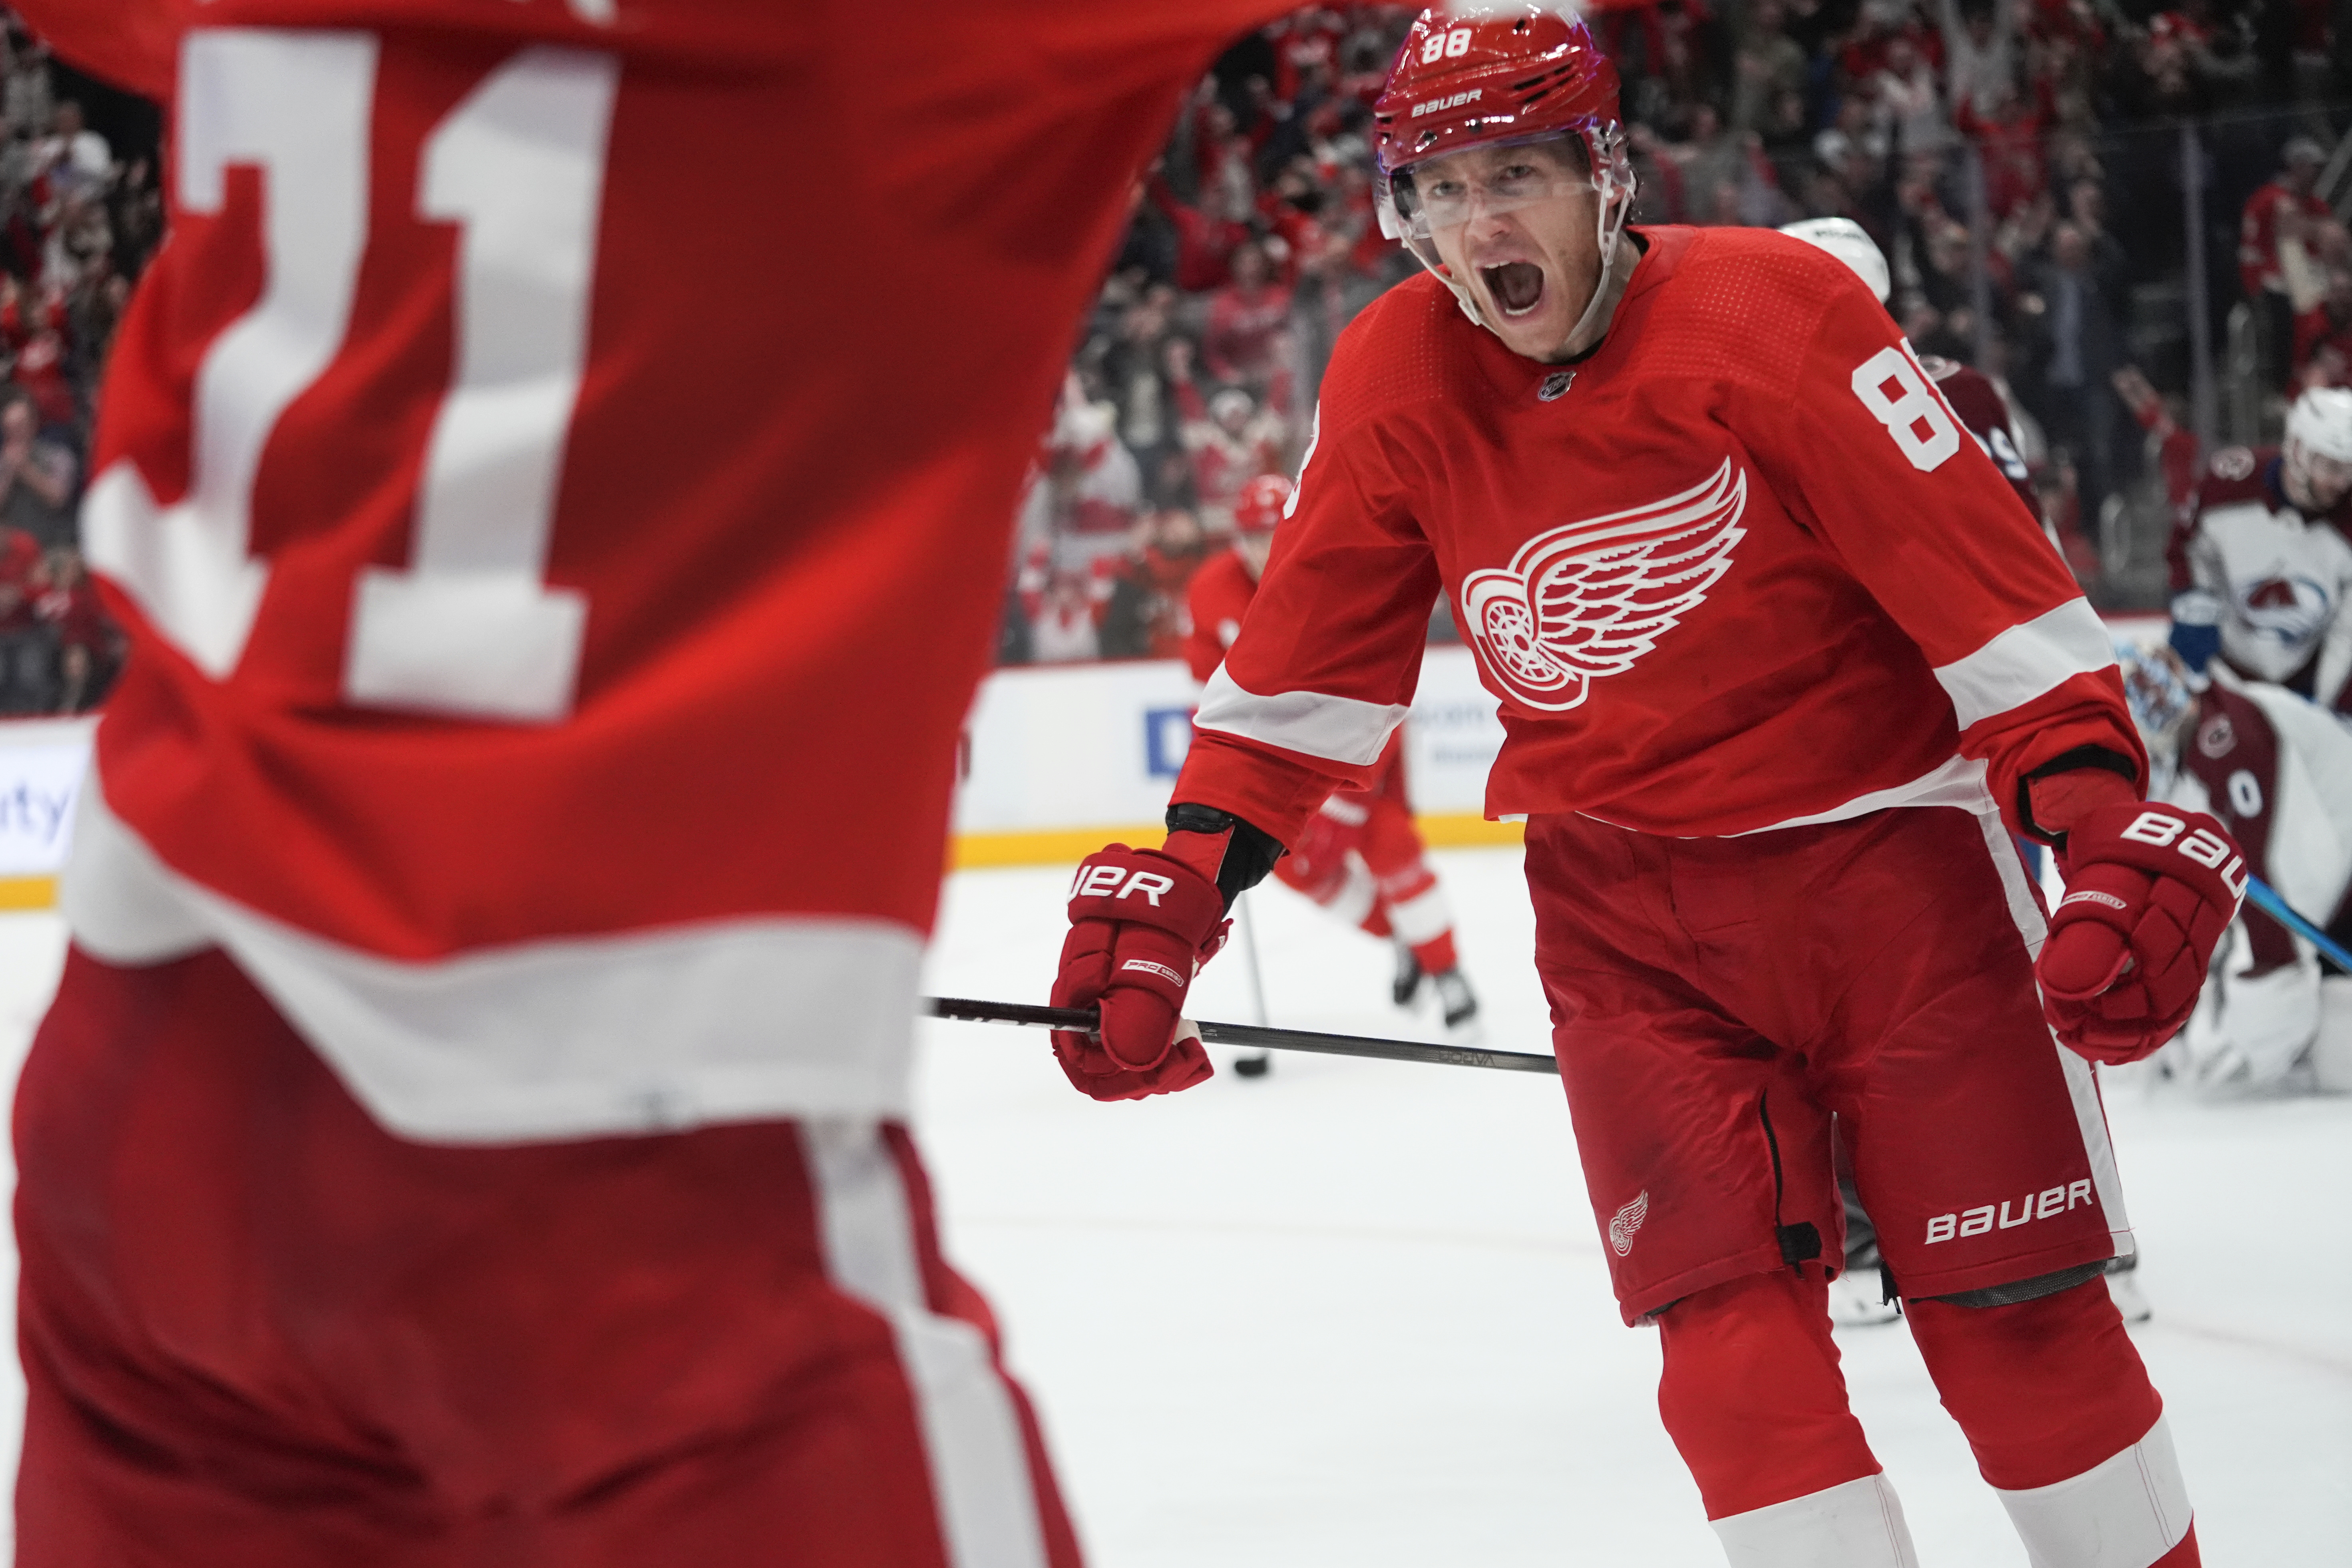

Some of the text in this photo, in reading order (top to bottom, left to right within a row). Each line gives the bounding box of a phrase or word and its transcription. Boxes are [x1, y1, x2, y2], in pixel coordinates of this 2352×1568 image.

[1422, 28, 1472, 64] 88
[80, 28, 623, 726] 71
[1851, 336, 1963, 473] 8
[1128, 961, 1158, 971] PRO
